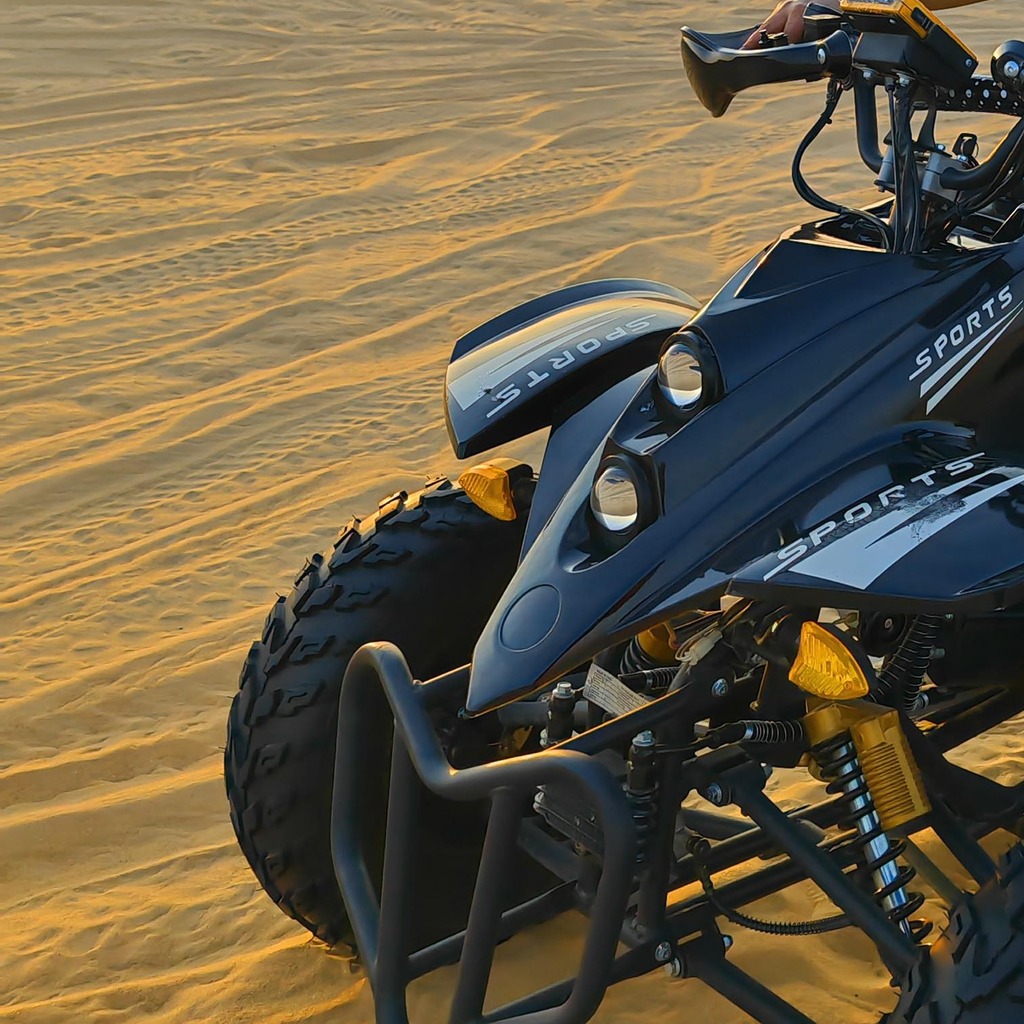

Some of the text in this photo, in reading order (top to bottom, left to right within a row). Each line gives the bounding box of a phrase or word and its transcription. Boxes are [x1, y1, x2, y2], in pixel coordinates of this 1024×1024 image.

[486, 313, 658, 418] SPORTS
[908, 284, 1013, 381] SPORTS
[763, 451, 985, 582] SPORTS
